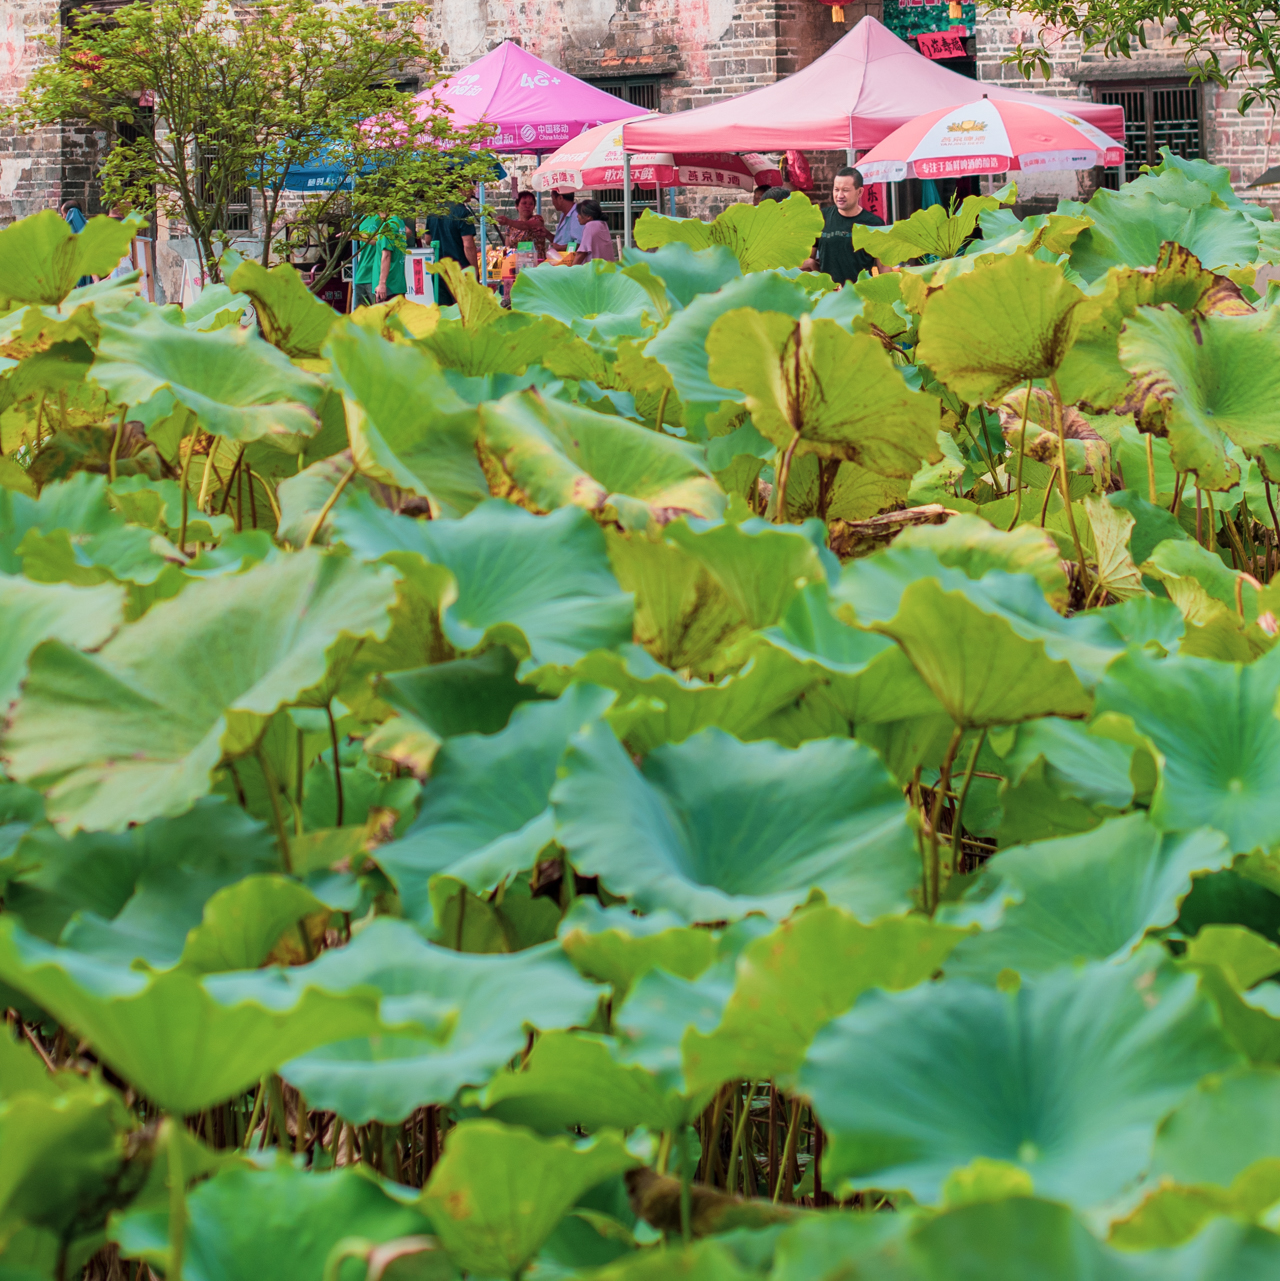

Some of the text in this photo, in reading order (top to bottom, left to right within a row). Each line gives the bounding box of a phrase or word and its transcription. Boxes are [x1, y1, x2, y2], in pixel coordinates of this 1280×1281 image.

[538, 124, 568, 134] 中国移动
[688, 170, 740, 186] 燕京啤酒
